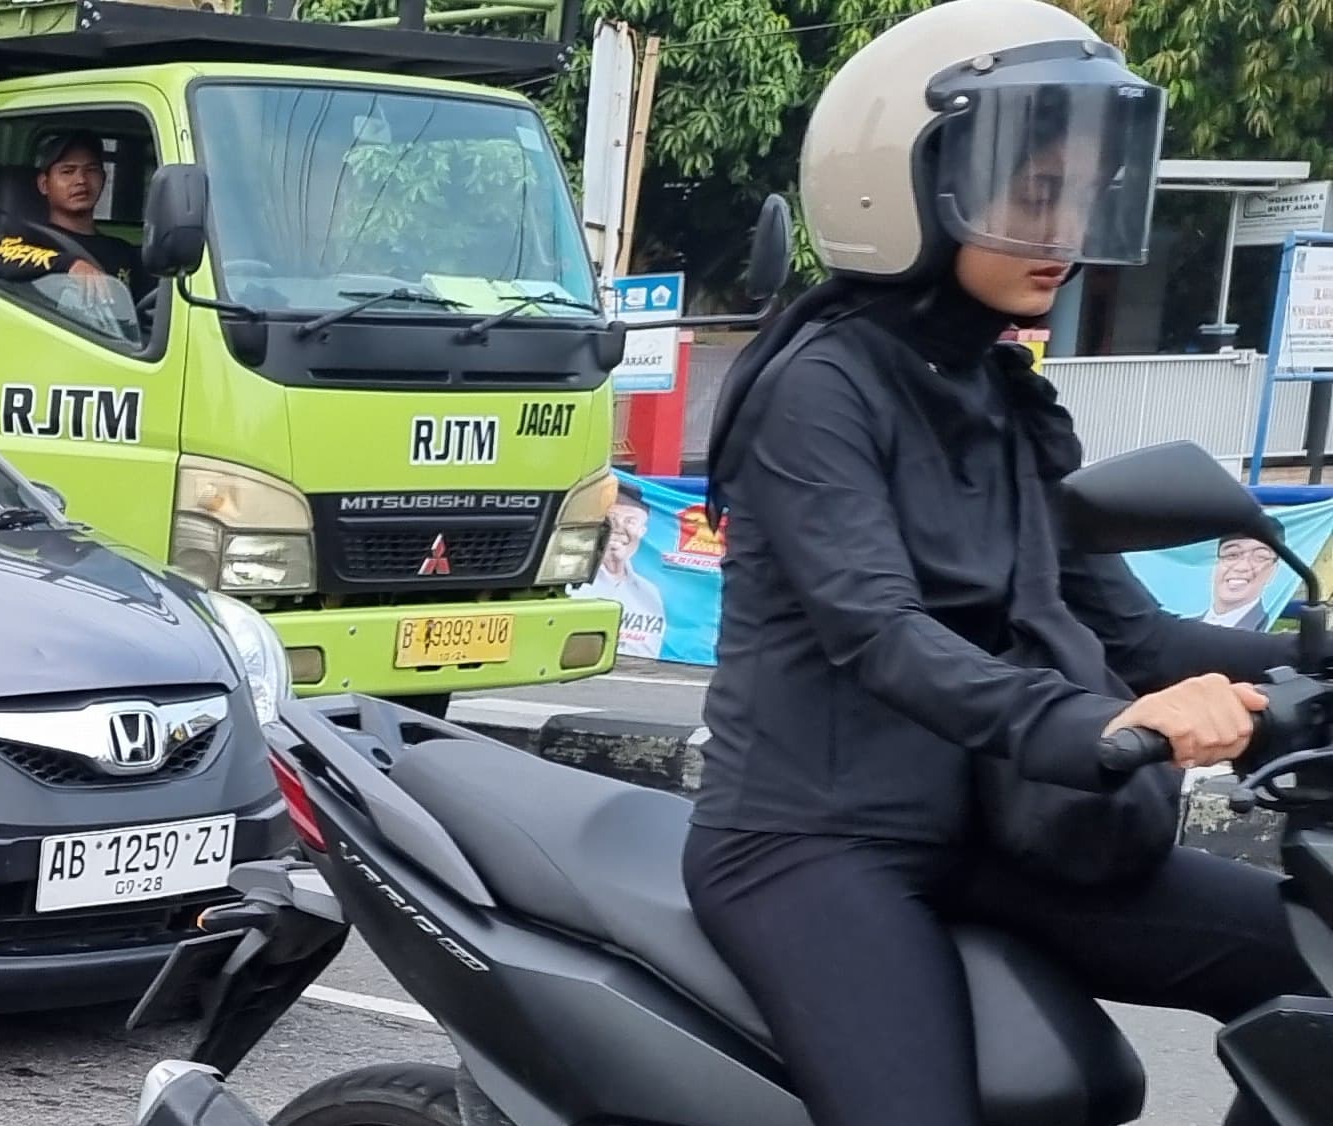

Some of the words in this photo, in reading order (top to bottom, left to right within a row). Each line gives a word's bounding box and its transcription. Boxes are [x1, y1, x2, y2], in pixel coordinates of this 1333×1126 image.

[1, 385, 141, 442] RJTM
[515, 402, 576, 437] JAGAT
[411, 418, 497, 462] RJTM
[340, 494, 474, 511] MITSUBISHI
[481, 494, 541, 509] FUSO
[402, 622, 413, 648] B
[432, 619, 474, 647] 9393
[48, 839, 86, 882] AB
[104, 830, 179, 876] 1259
[193, 824, 231, 866] ZJ
